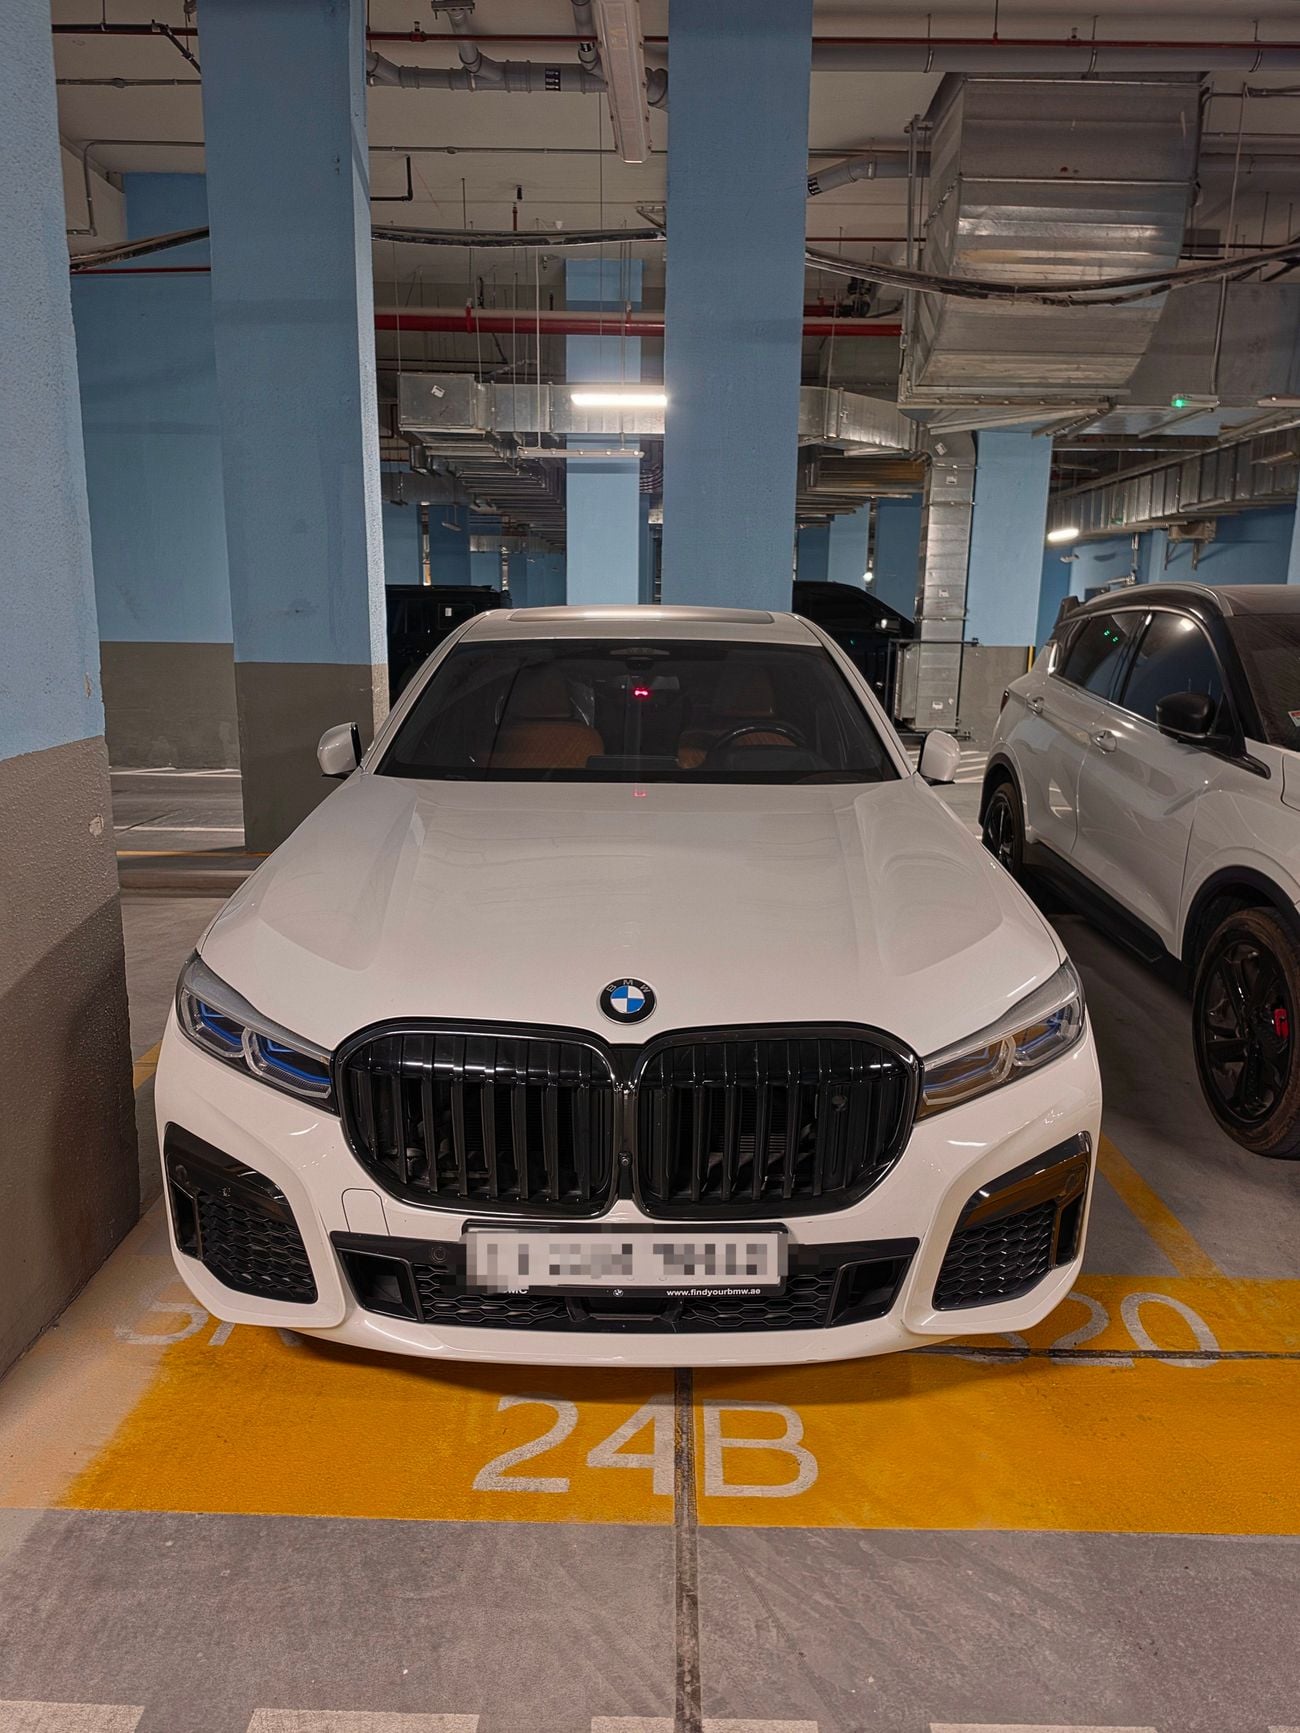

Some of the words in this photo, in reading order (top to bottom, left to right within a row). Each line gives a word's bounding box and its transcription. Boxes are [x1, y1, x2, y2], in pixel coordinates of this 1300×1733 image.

[606, 979, 651, 993] BMW
[666, 1288, 761, 1297] www.findyourbmw.ae
[472, 1391, 819, 1497] 24B
